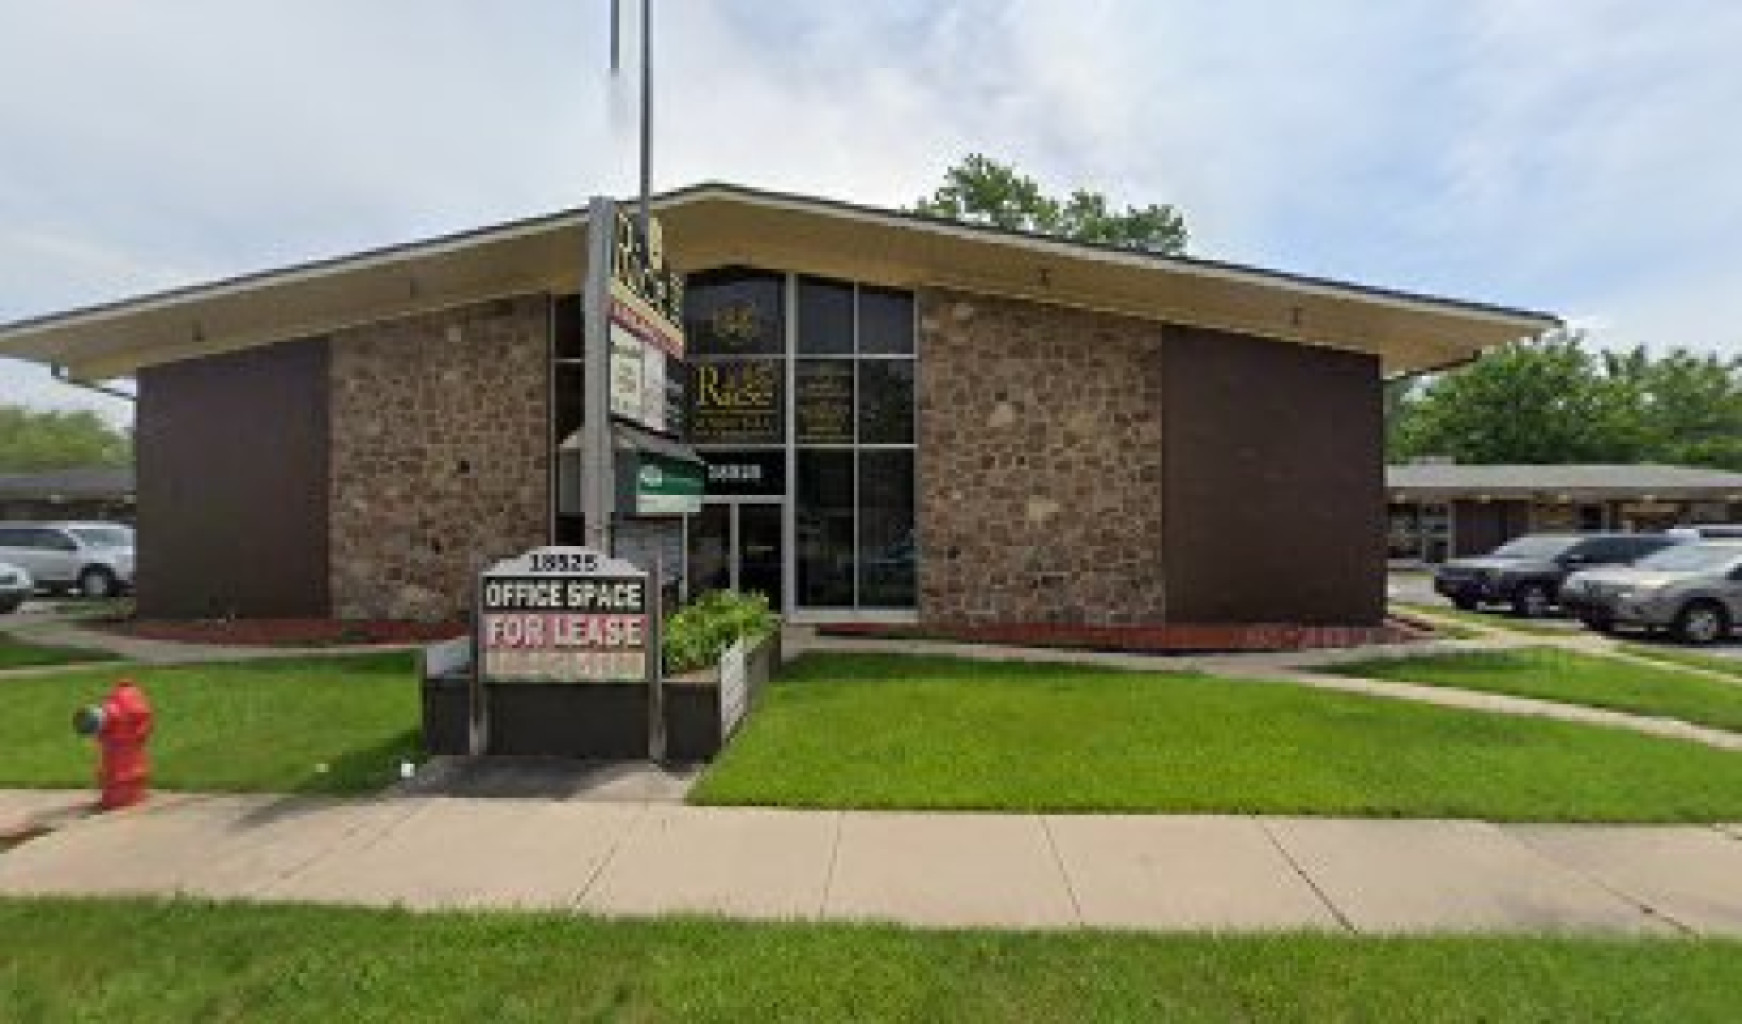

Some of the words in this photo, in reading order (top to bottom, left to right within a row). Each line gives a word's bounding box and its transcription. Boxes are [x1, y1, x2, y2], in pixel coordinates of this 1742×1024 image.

[529, 553, 599, 572] 18525
[486, 582, 561, 607] OFFICE
[567, 582, 642, 607] SPACE
[488, 615, 546, 646] FOR
[553, 615, 643, 646] LEASE
